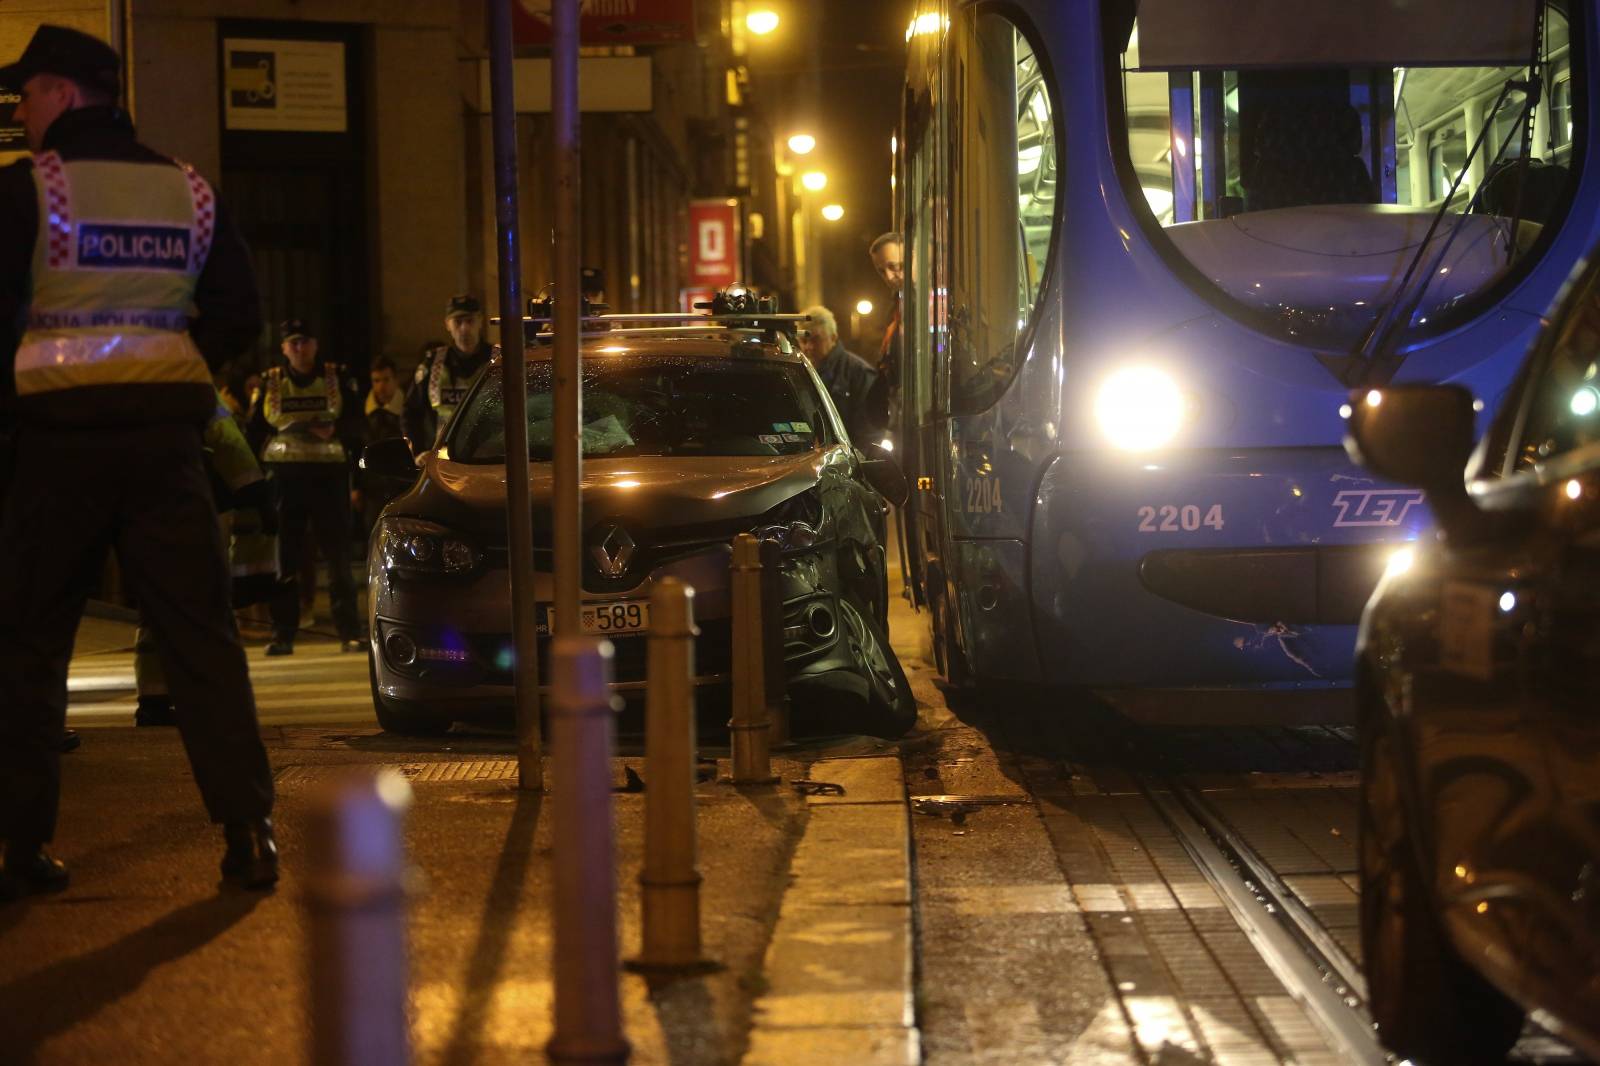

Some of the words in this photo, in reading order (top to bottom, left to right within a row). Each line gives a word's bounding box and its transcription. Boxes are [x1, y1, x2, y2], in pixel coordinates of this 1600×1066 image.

[82, 233, 187, 260] POLICIJA
[967, 477, 1002, 513] 2204
[1332, 488, 1425, 527] ZET
[1137, 504, 1225, 532] 2204
